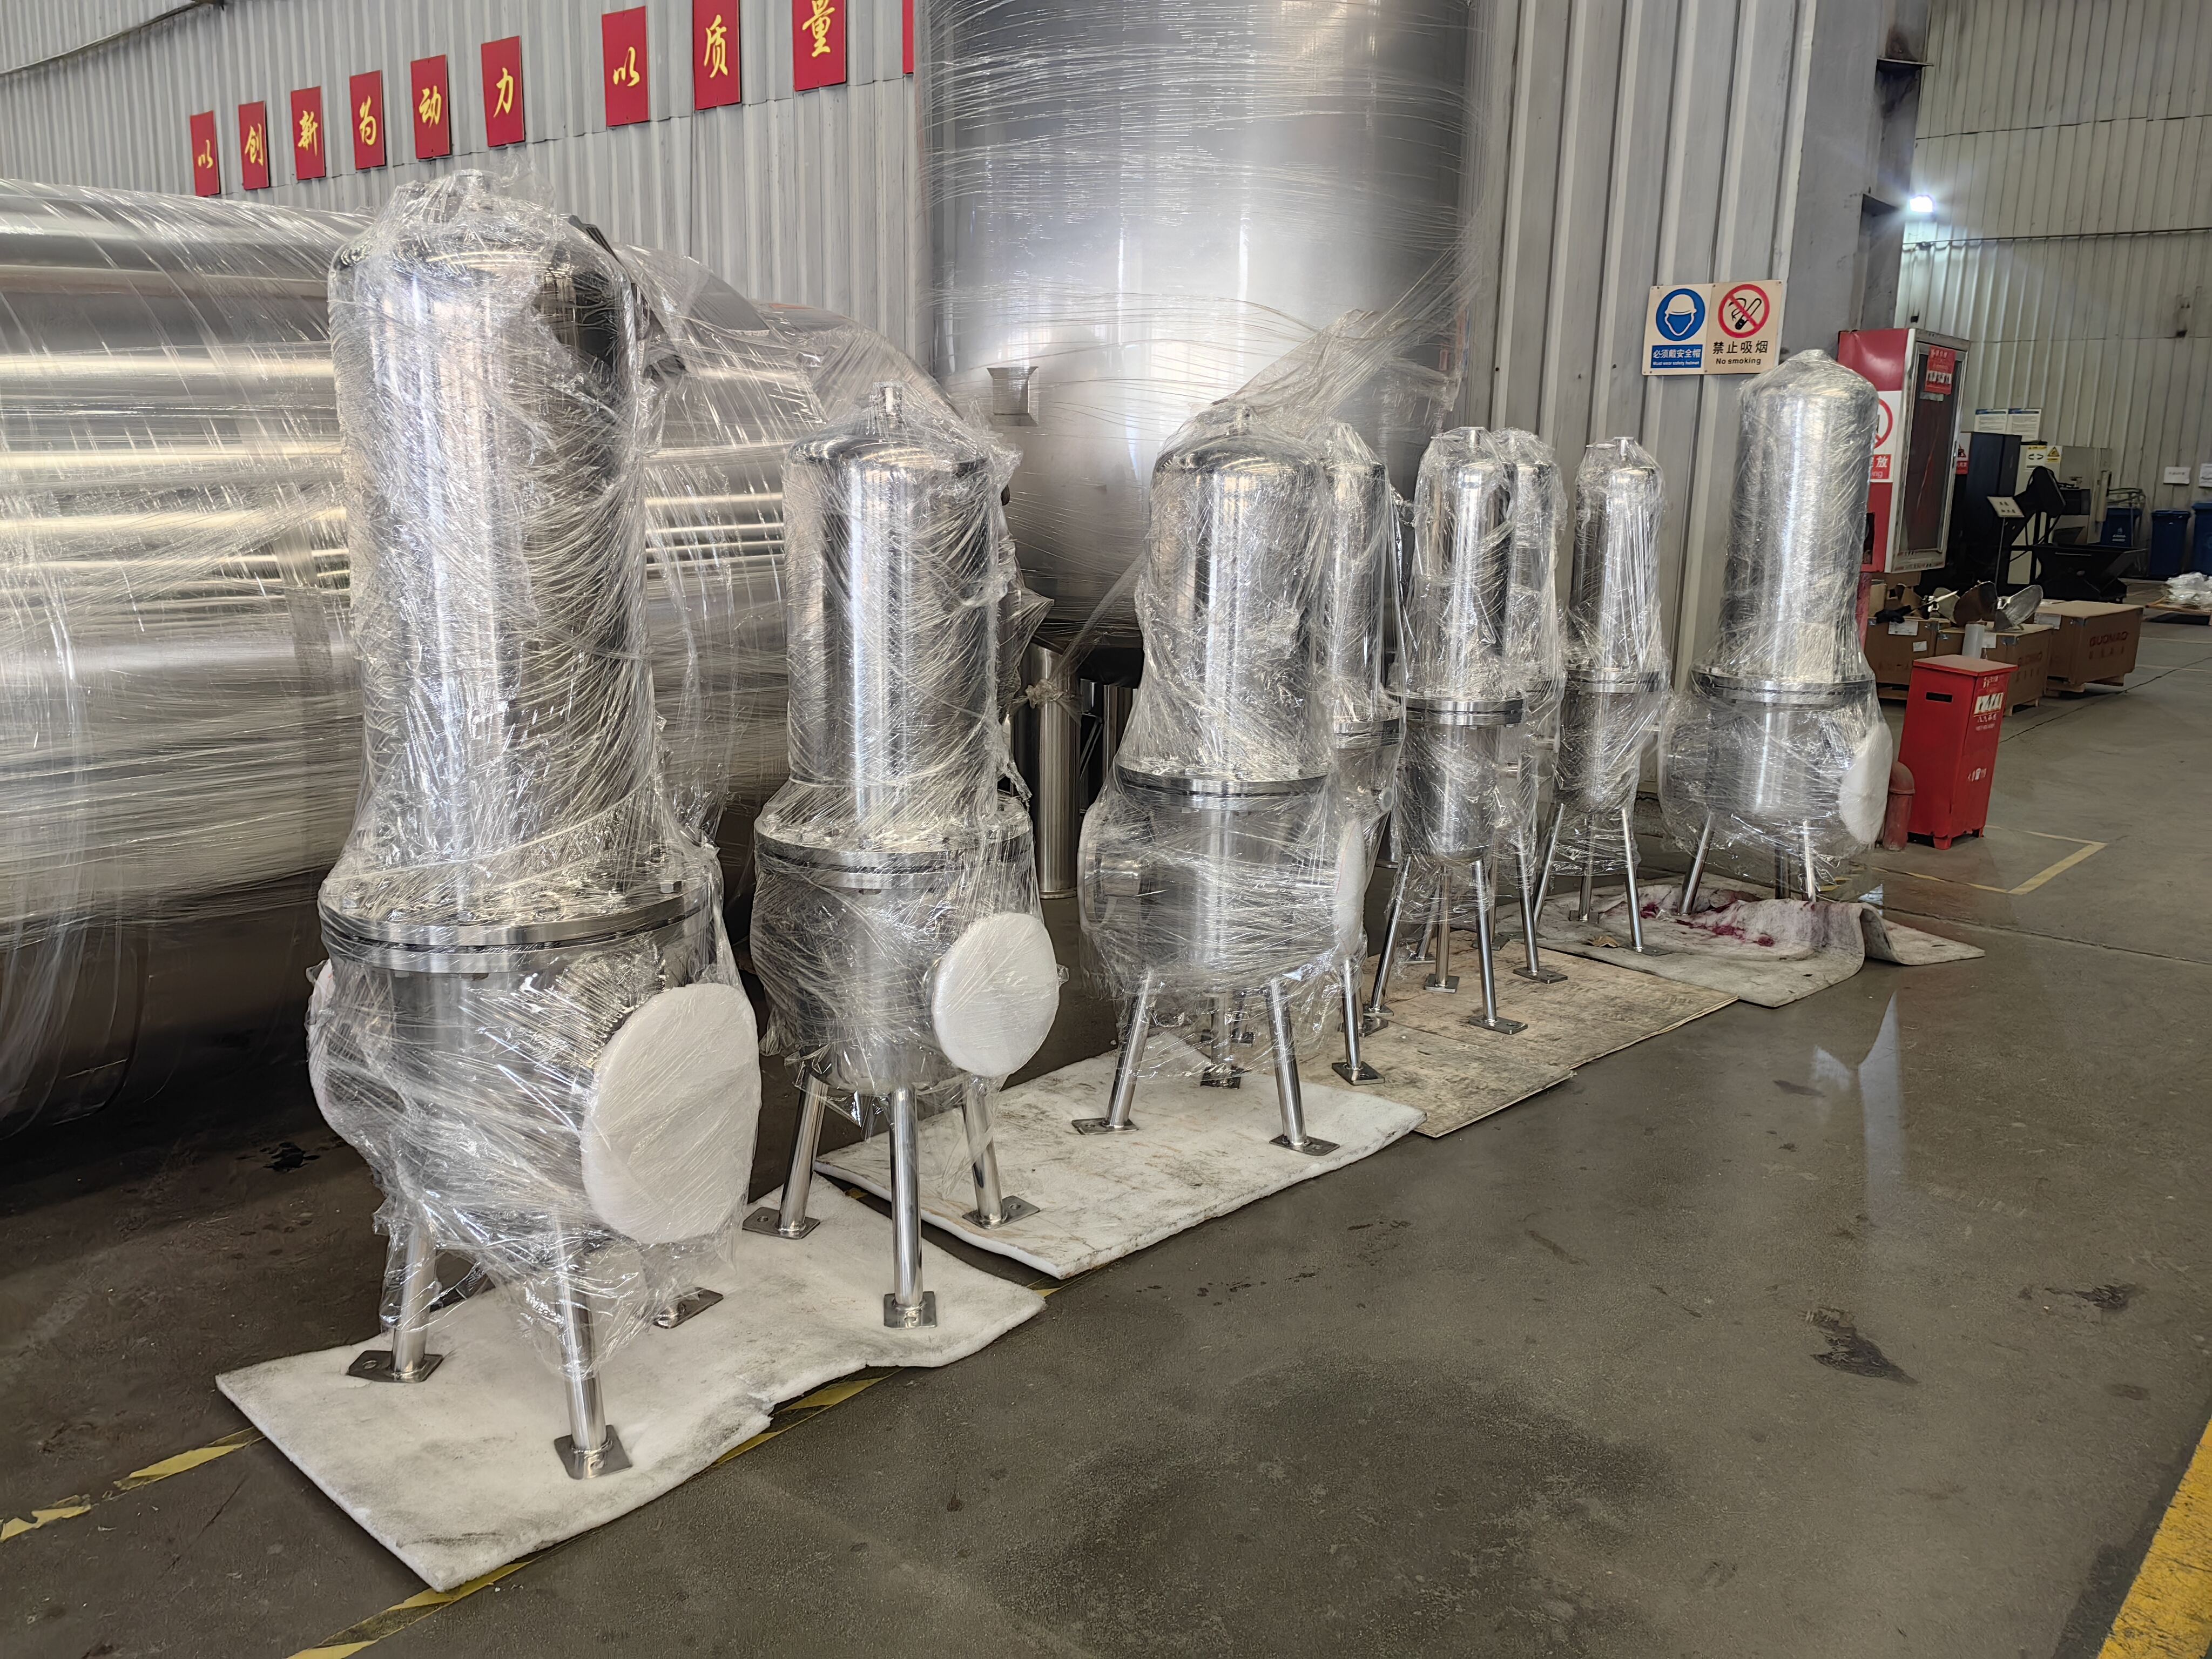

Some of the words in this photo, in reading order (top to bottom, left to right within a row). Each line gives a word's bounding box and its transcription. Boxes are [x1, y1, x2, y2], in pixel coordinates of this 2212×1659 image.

[198, 68, 514, 169] 以创新为动力
[1713, 340, 1768, 354] 禁止吸烟
[1728, 357, 1762, 365] smoking
